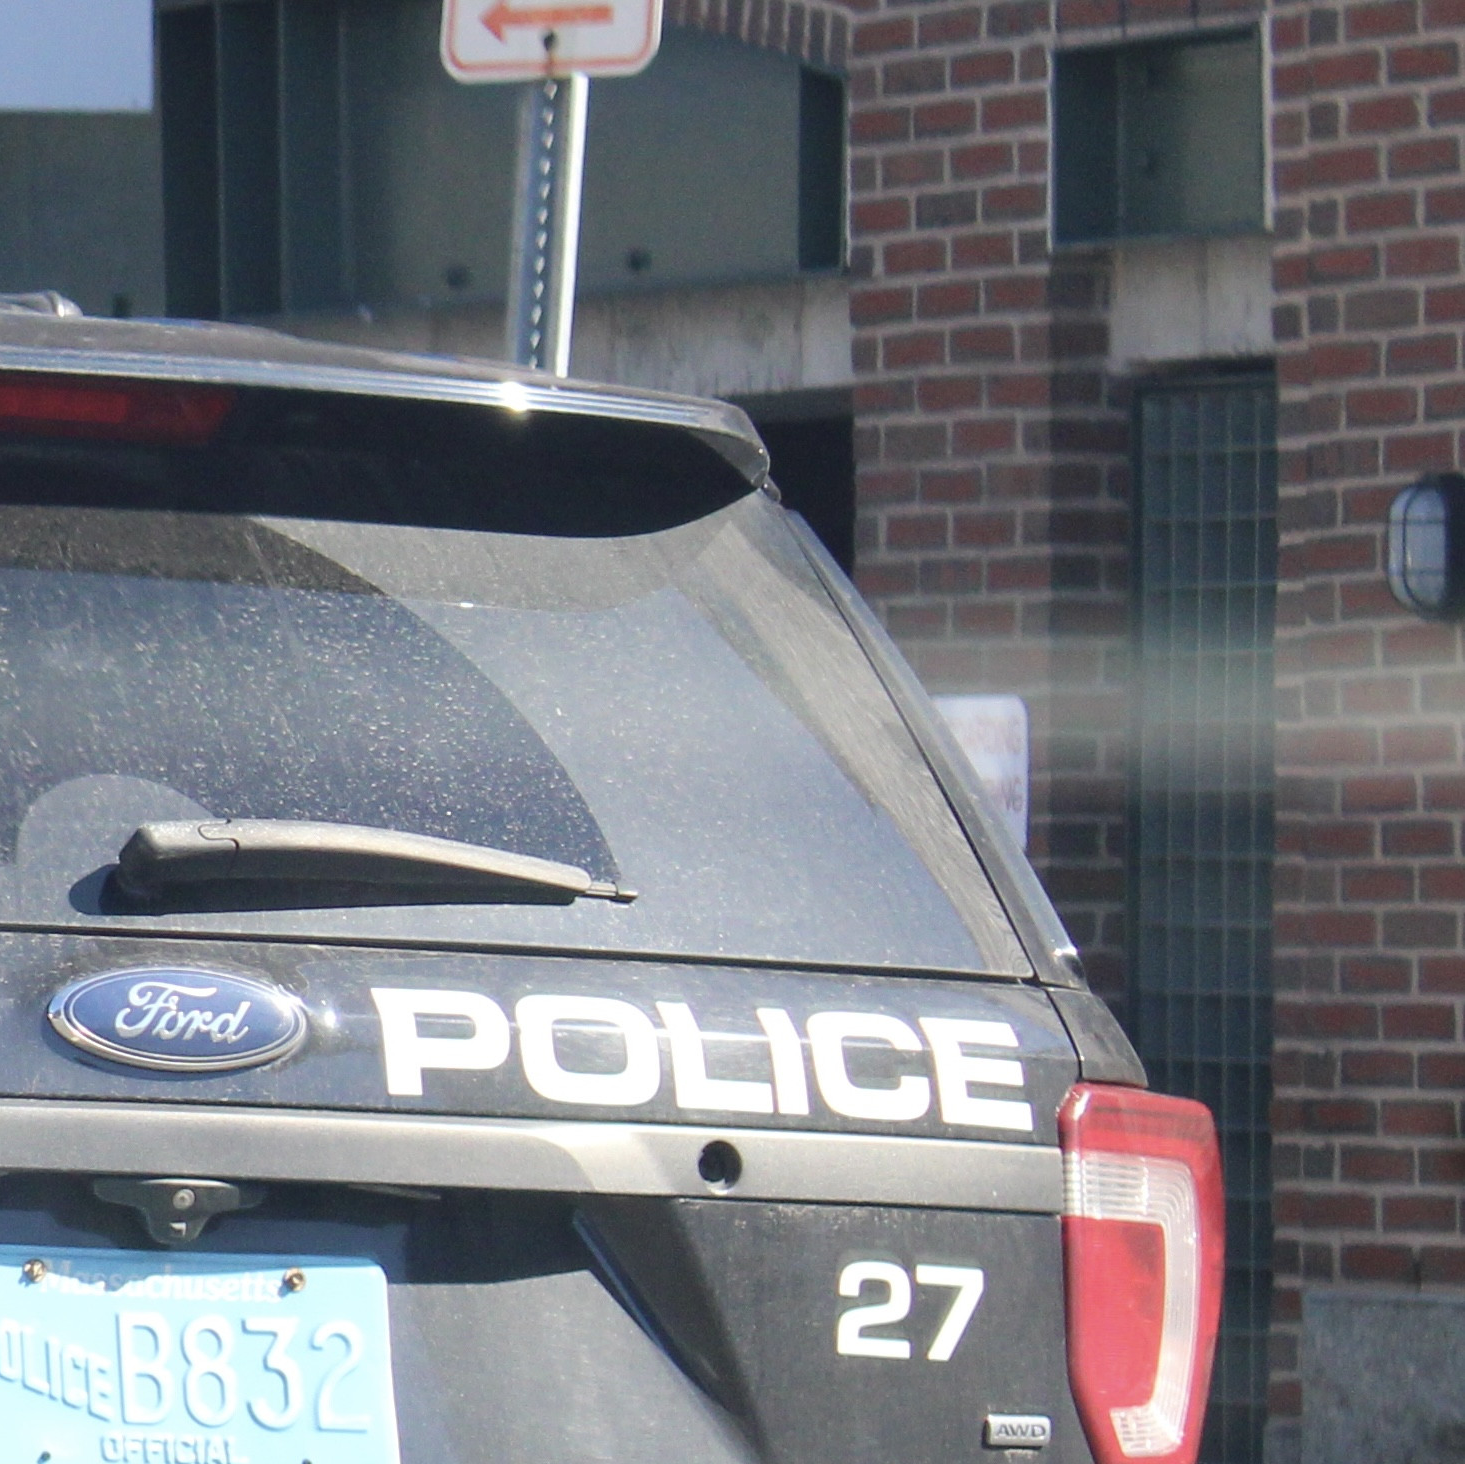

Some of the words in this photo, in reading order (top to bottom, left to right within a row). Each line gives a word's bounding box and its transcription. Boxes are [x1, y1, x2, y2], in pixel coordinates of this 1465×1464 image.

[115, 981, 251, 1043] Ford
[370, 987, 1033, 1131] POLICE
[39, 1257, 283, 1304] Massachusetts
[836, 1262, 985, 1361] 27
[115, 1310, 371, 1434] B832
[997, 1423, 1046, 1438] AWD
